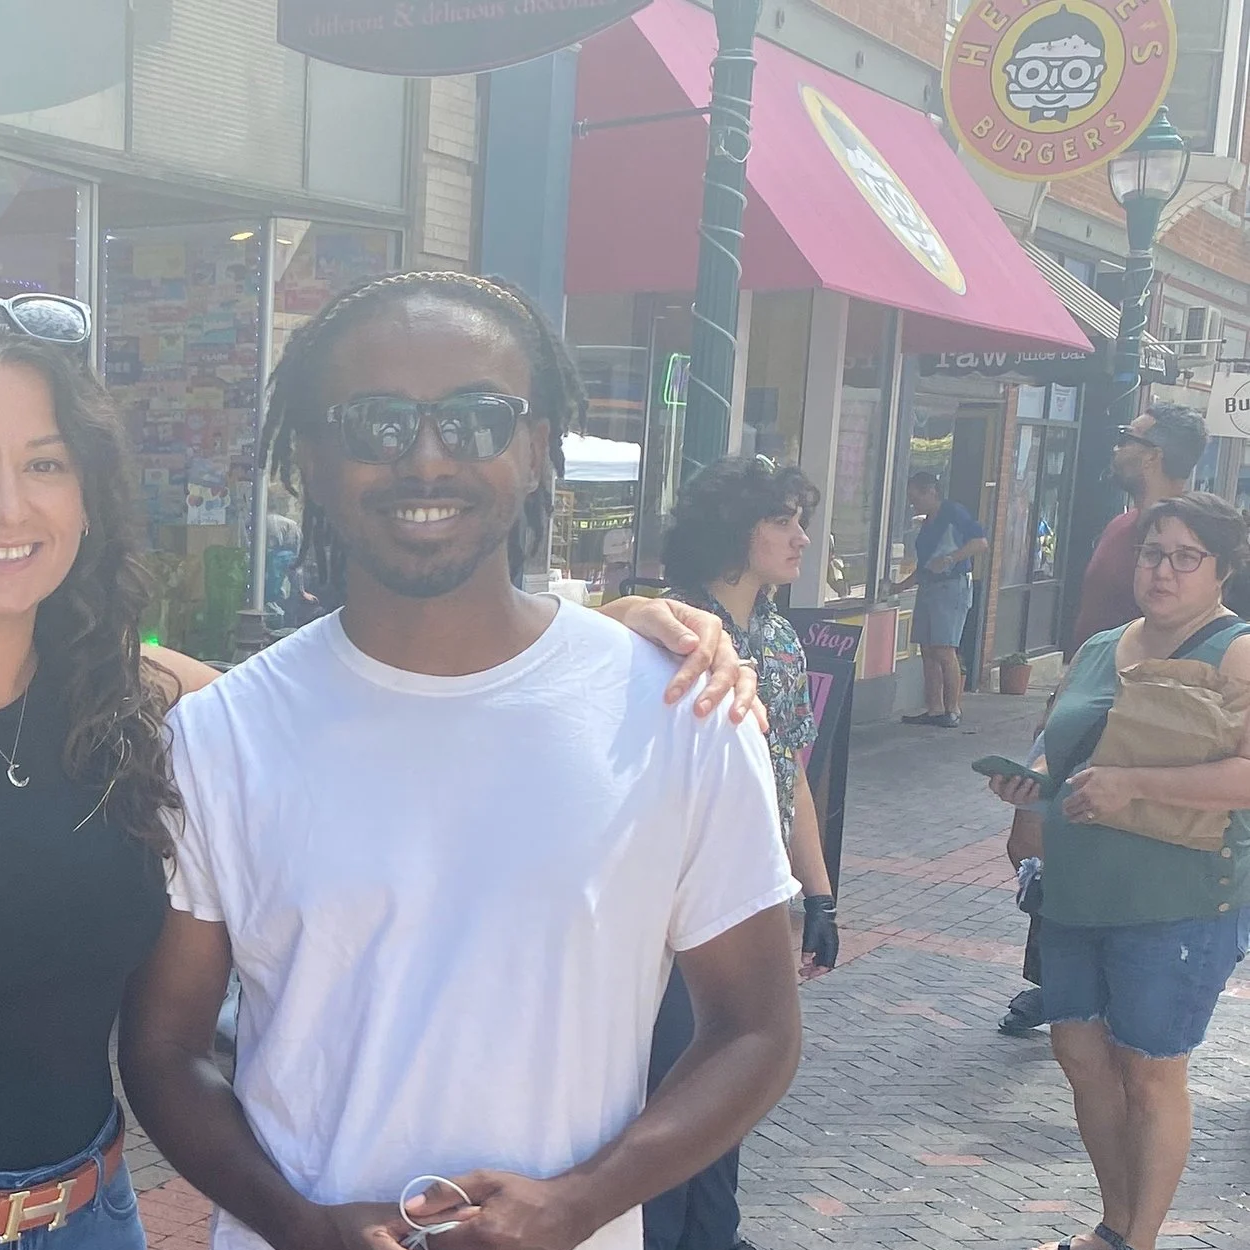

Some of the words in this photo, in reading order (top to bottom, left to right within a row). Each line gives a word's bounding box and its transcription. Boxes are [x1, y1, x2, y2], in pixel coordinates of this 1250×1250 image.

[307, 12, 384, 37] different
[393, 2, 415, 27] &
[422, 1, 505, 25] delicious
[971, 112, 1126, 164] BURGERS
[935, 352, 1007, 368] raw
[1225, 397, 1250, 413] BU
[802, 623, 855, 657] Shop
